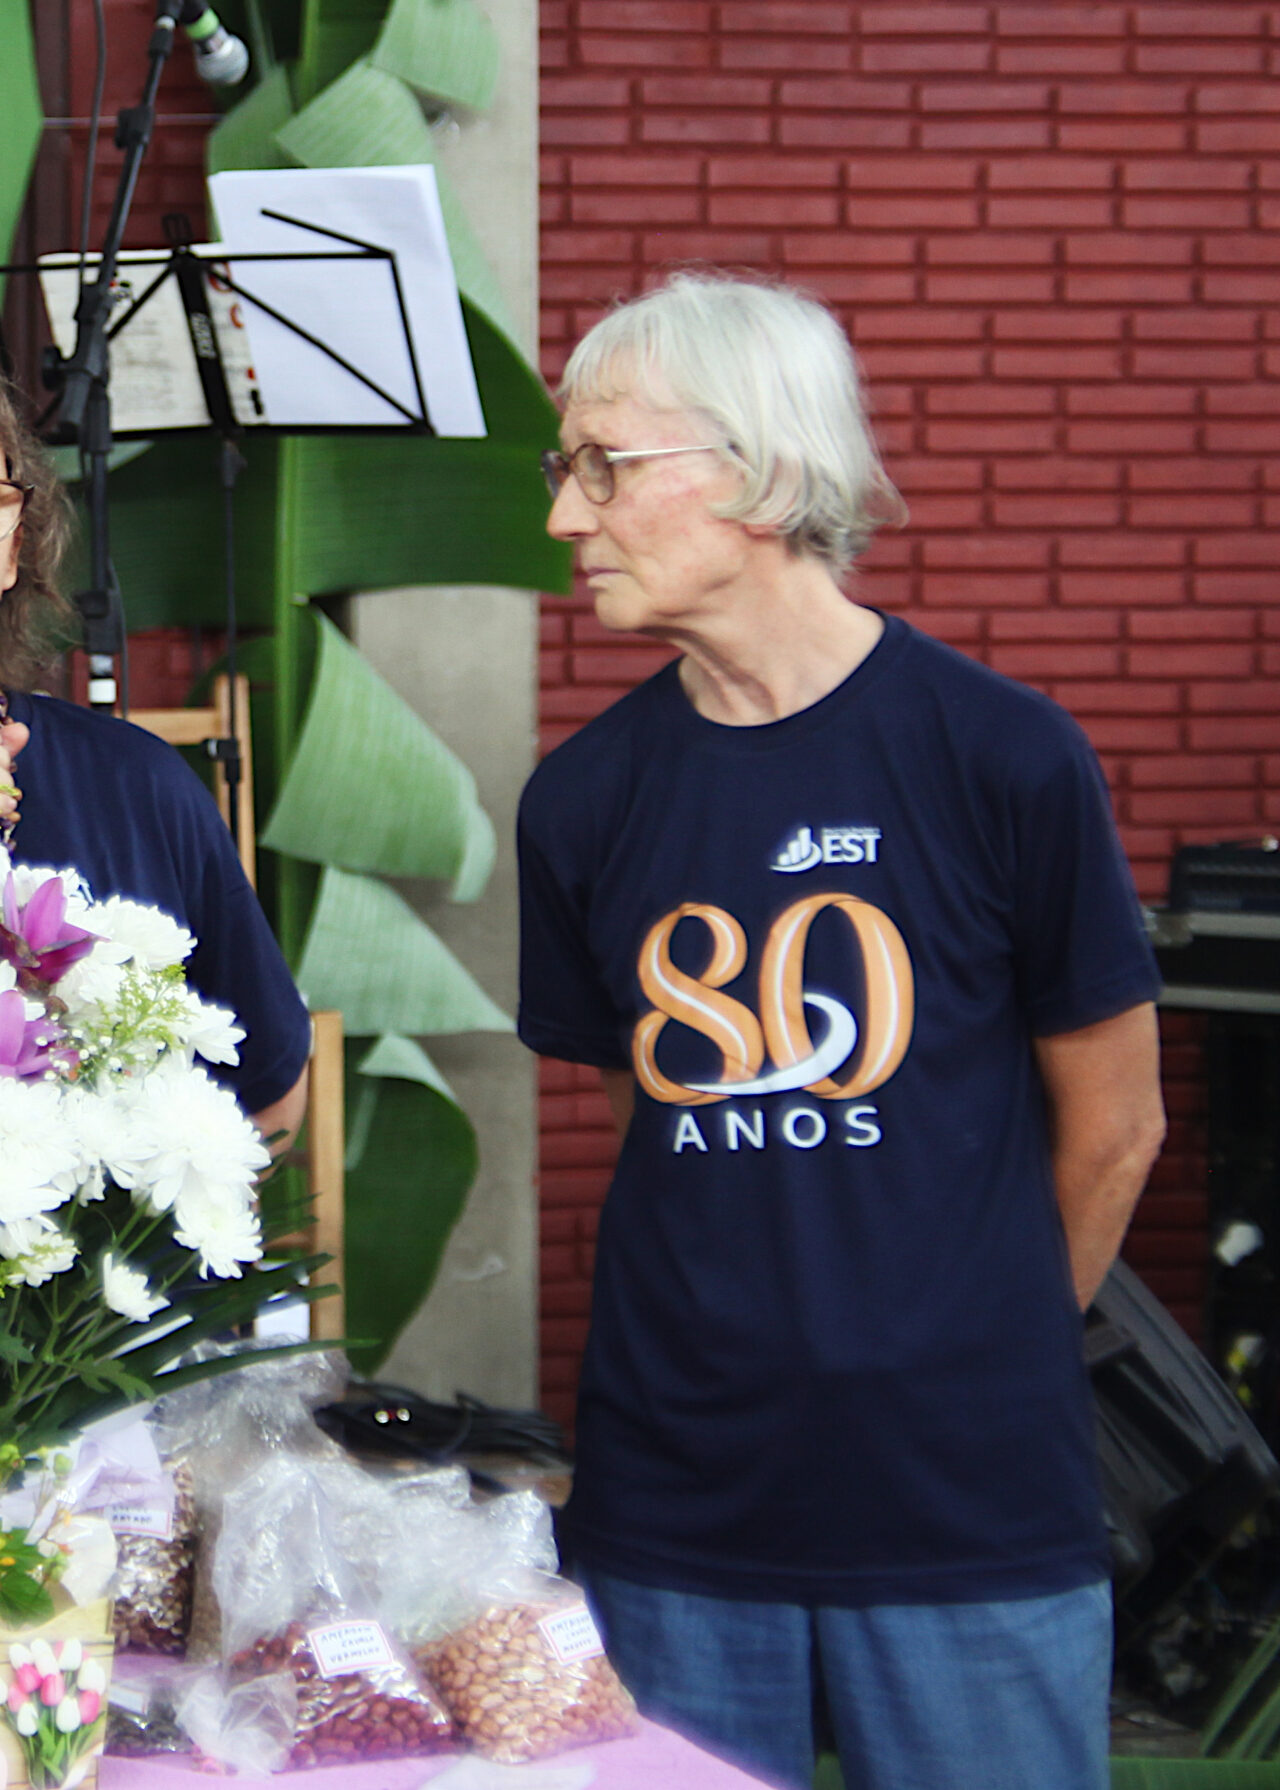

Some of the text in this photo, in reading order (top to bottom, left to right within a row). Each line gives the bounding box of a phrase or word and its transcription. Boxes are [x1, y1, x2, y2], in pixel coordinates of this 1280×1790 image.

[822, 834, 882, 863] EST
[631, 892, 915, 1107] 80
[673, 1105, 883, 1153] ANOS
